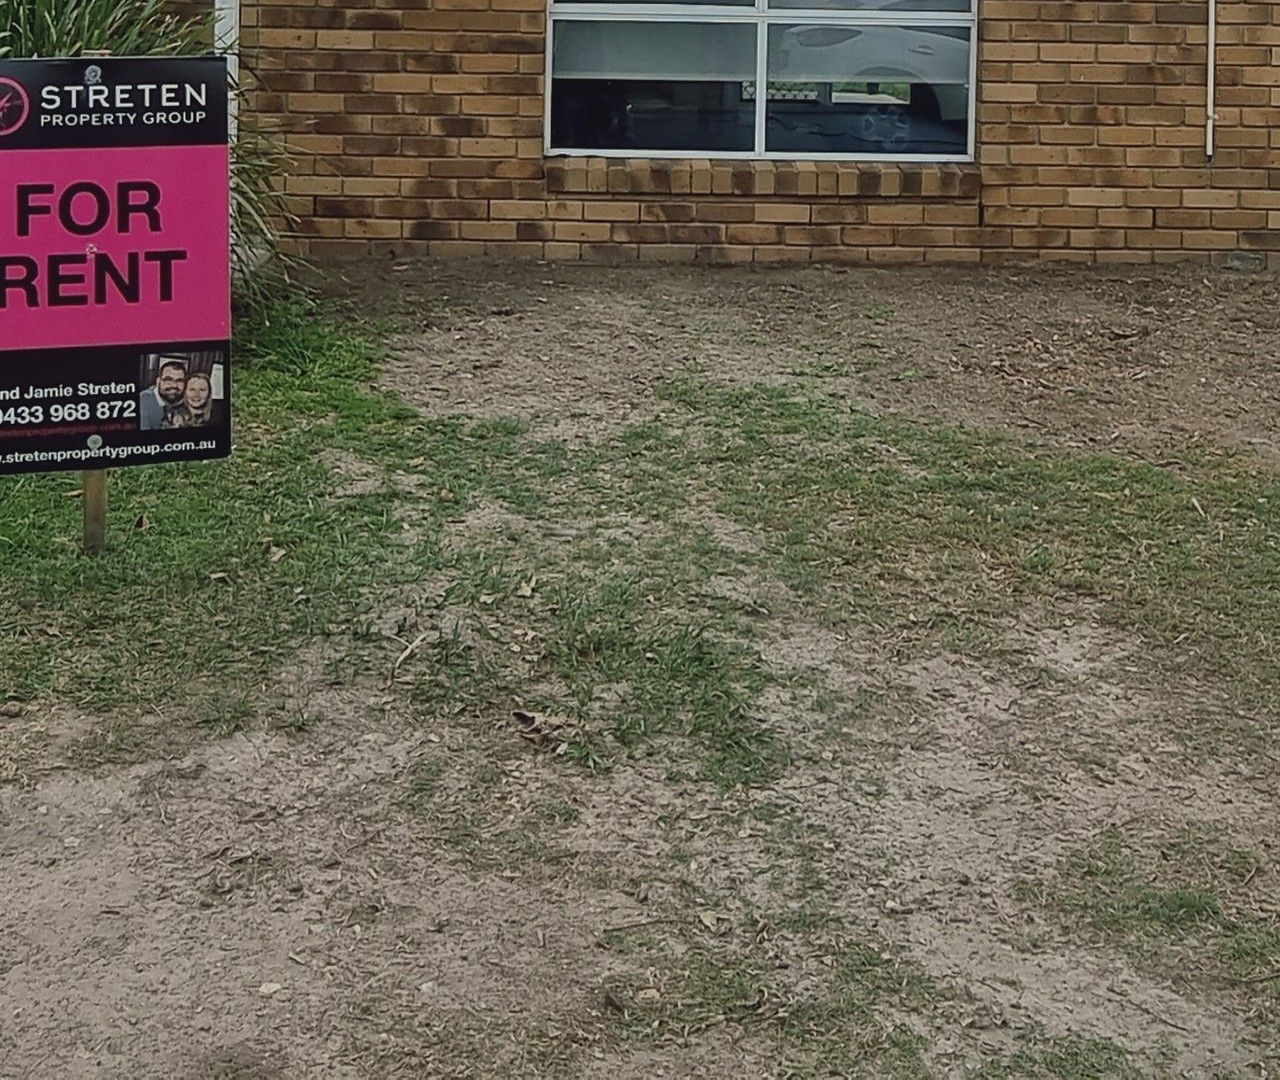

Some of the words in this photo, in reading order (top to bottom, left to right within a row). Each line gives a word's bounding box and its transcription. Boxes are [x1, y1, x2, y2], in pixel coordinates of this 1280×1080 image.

[41, 83, 207, 109] STRETEN
[41, 113, 136, 127] PROPERTY
[142, 111, 206, 125] GROUP
[16, 181, 163, 237] FOR
[24, 385, 73, 400] Jamie
[78, 382, 136, 397] Streten
[50, 403, 91, 422] 968
[96, 400, 136, 419] 872
